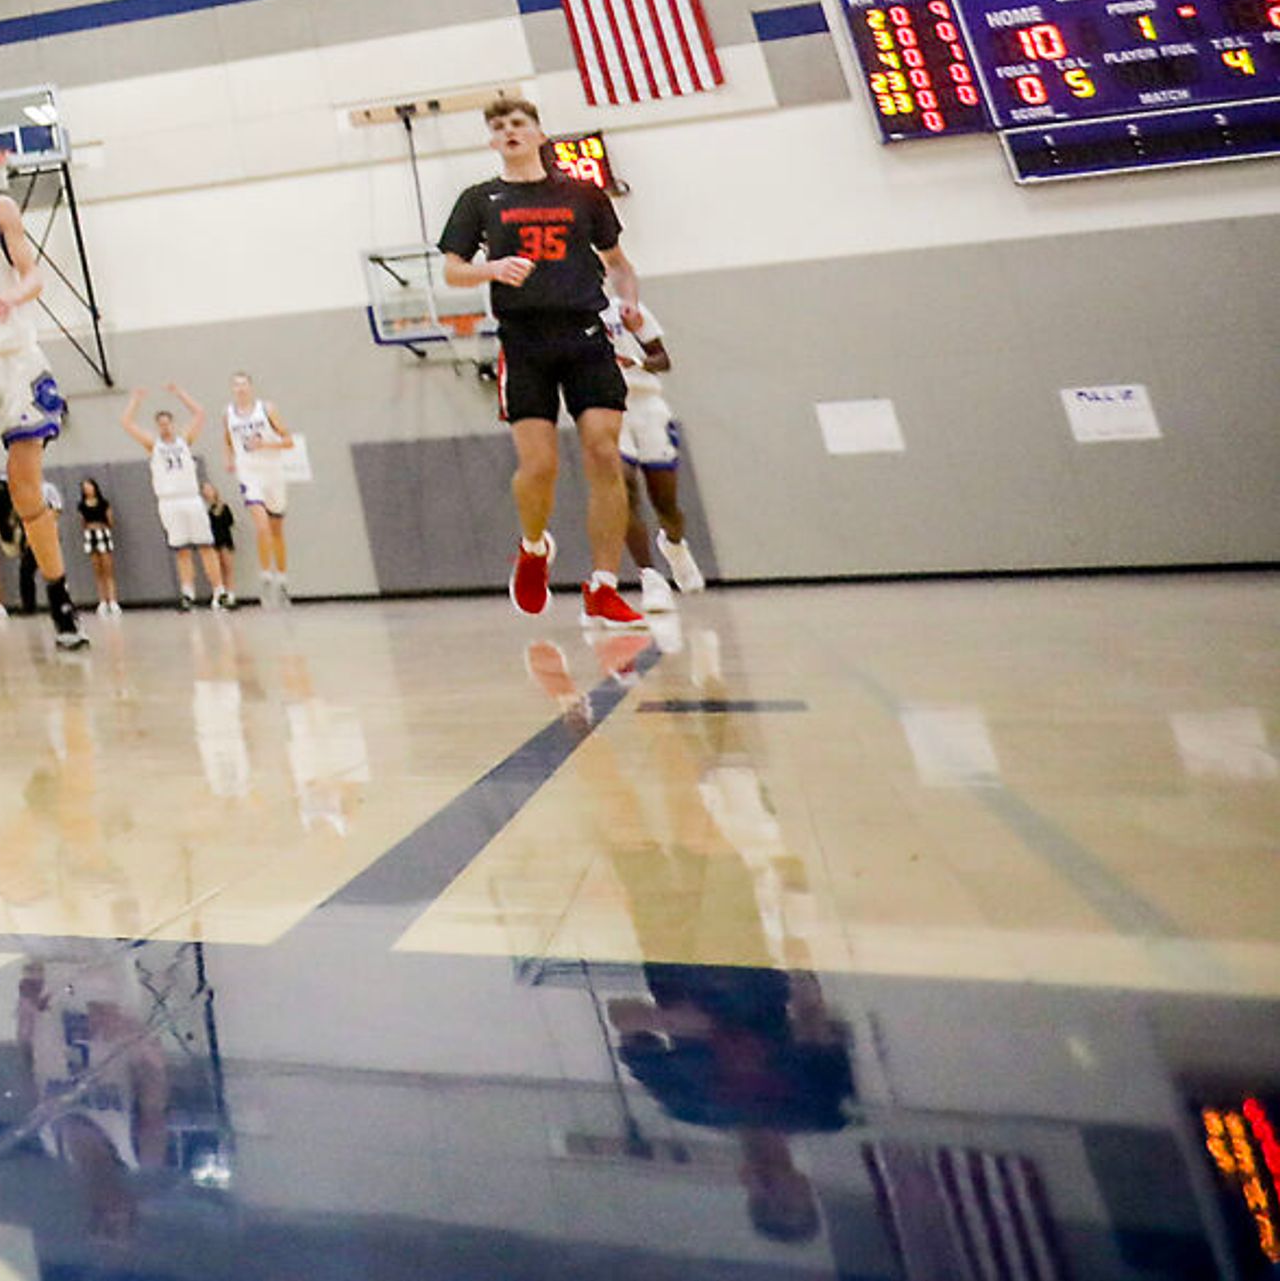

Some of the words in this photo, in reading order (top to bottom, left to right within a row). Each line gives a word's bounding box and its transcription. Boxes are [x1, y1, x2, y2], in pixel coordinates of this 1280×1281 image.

[866, 9, 886, 30] 2
[890, 5, 911, 26] 0
[928, 0, 951, 19] 9
[985, 6, 1044, 28] HOME
[1137, 15, 1157, 40] 1
[873, 30, 894, 51] 3
[896, 27, 917, 47] 0
[936, 21, 957, 42] 0
[1017, 24, 1067, 61] 10
[878, 52, 900, 70] 4
[903, 48, 924, 68] 0
[1103, 47, 1158, 65] PLAYER
[1160, 42, 1198, 57] FOUL
[1221, 48, 1256, 76] 4
[870, 71, 908, 94] 23
[909, 69, 931, 90] 0
[948, 63, 972, 84] 0
[1015, 73, 1049, 106] 0
[1063, 67, 1097, 99] 5
[877, 92, 914, 115] 33
[915, 90, 938, 109] 0
[955, 84, 979, 106] 0
[1139, 89, 1190, 105] MATCH
[922, 111, 945, 132] 0
[518, 226, 567, 261] 35
